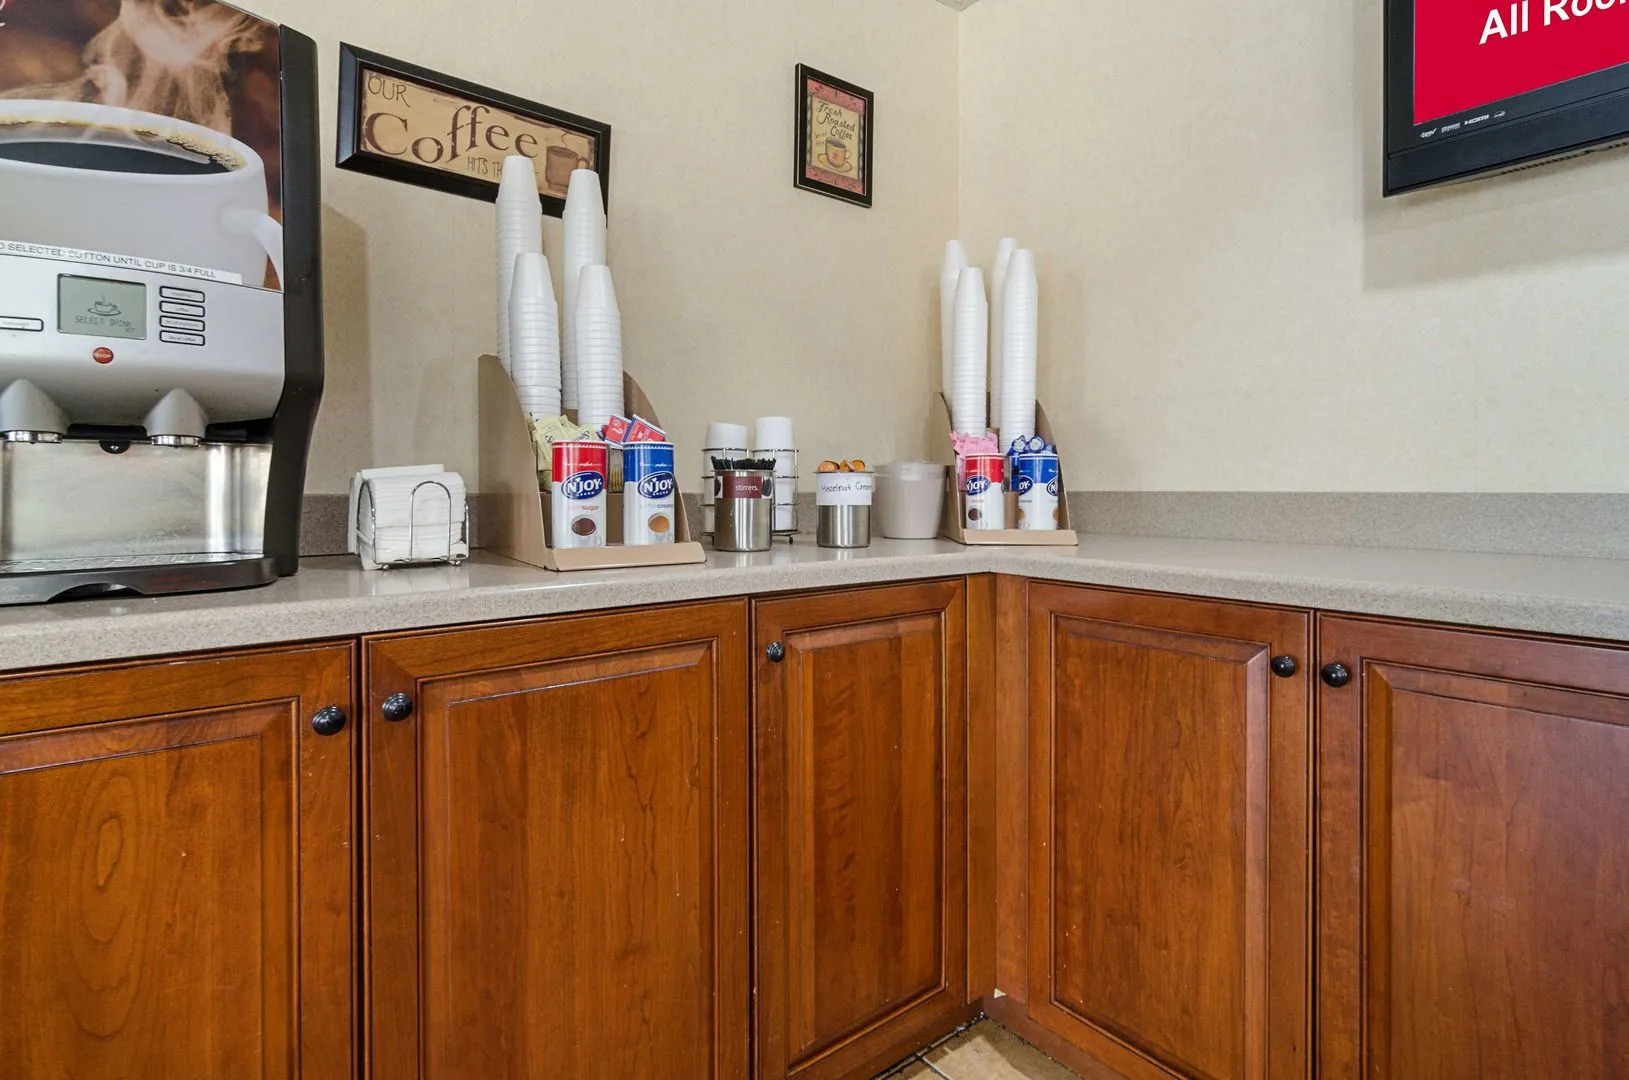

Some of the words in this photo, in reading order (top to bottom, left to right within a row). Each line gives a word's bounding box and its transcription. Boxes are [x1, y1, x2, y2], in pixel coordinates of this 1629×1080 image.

[1479, 0, 1529, 46] All
[367, 75, 411, 108] OUR
[815, 100, 843, 118] Fresh
[816, 112, 856, 132] Roasted
[364, 104, 539, 164] Coffee
[829, 125, 853, 140] Coffee
[467, 156, 489, 175] HITS
[7, 243, 66, 257] SELECTED
[68, 250, 111, 263] BUTTON
[113, 256, 143, 267] UNTIL
[145, 260, 166, 269] CUP
[168, 264, 177, 272] IS
[179, 265, 192, 274] 3/4
[194, 268, 217, 278] FULL
